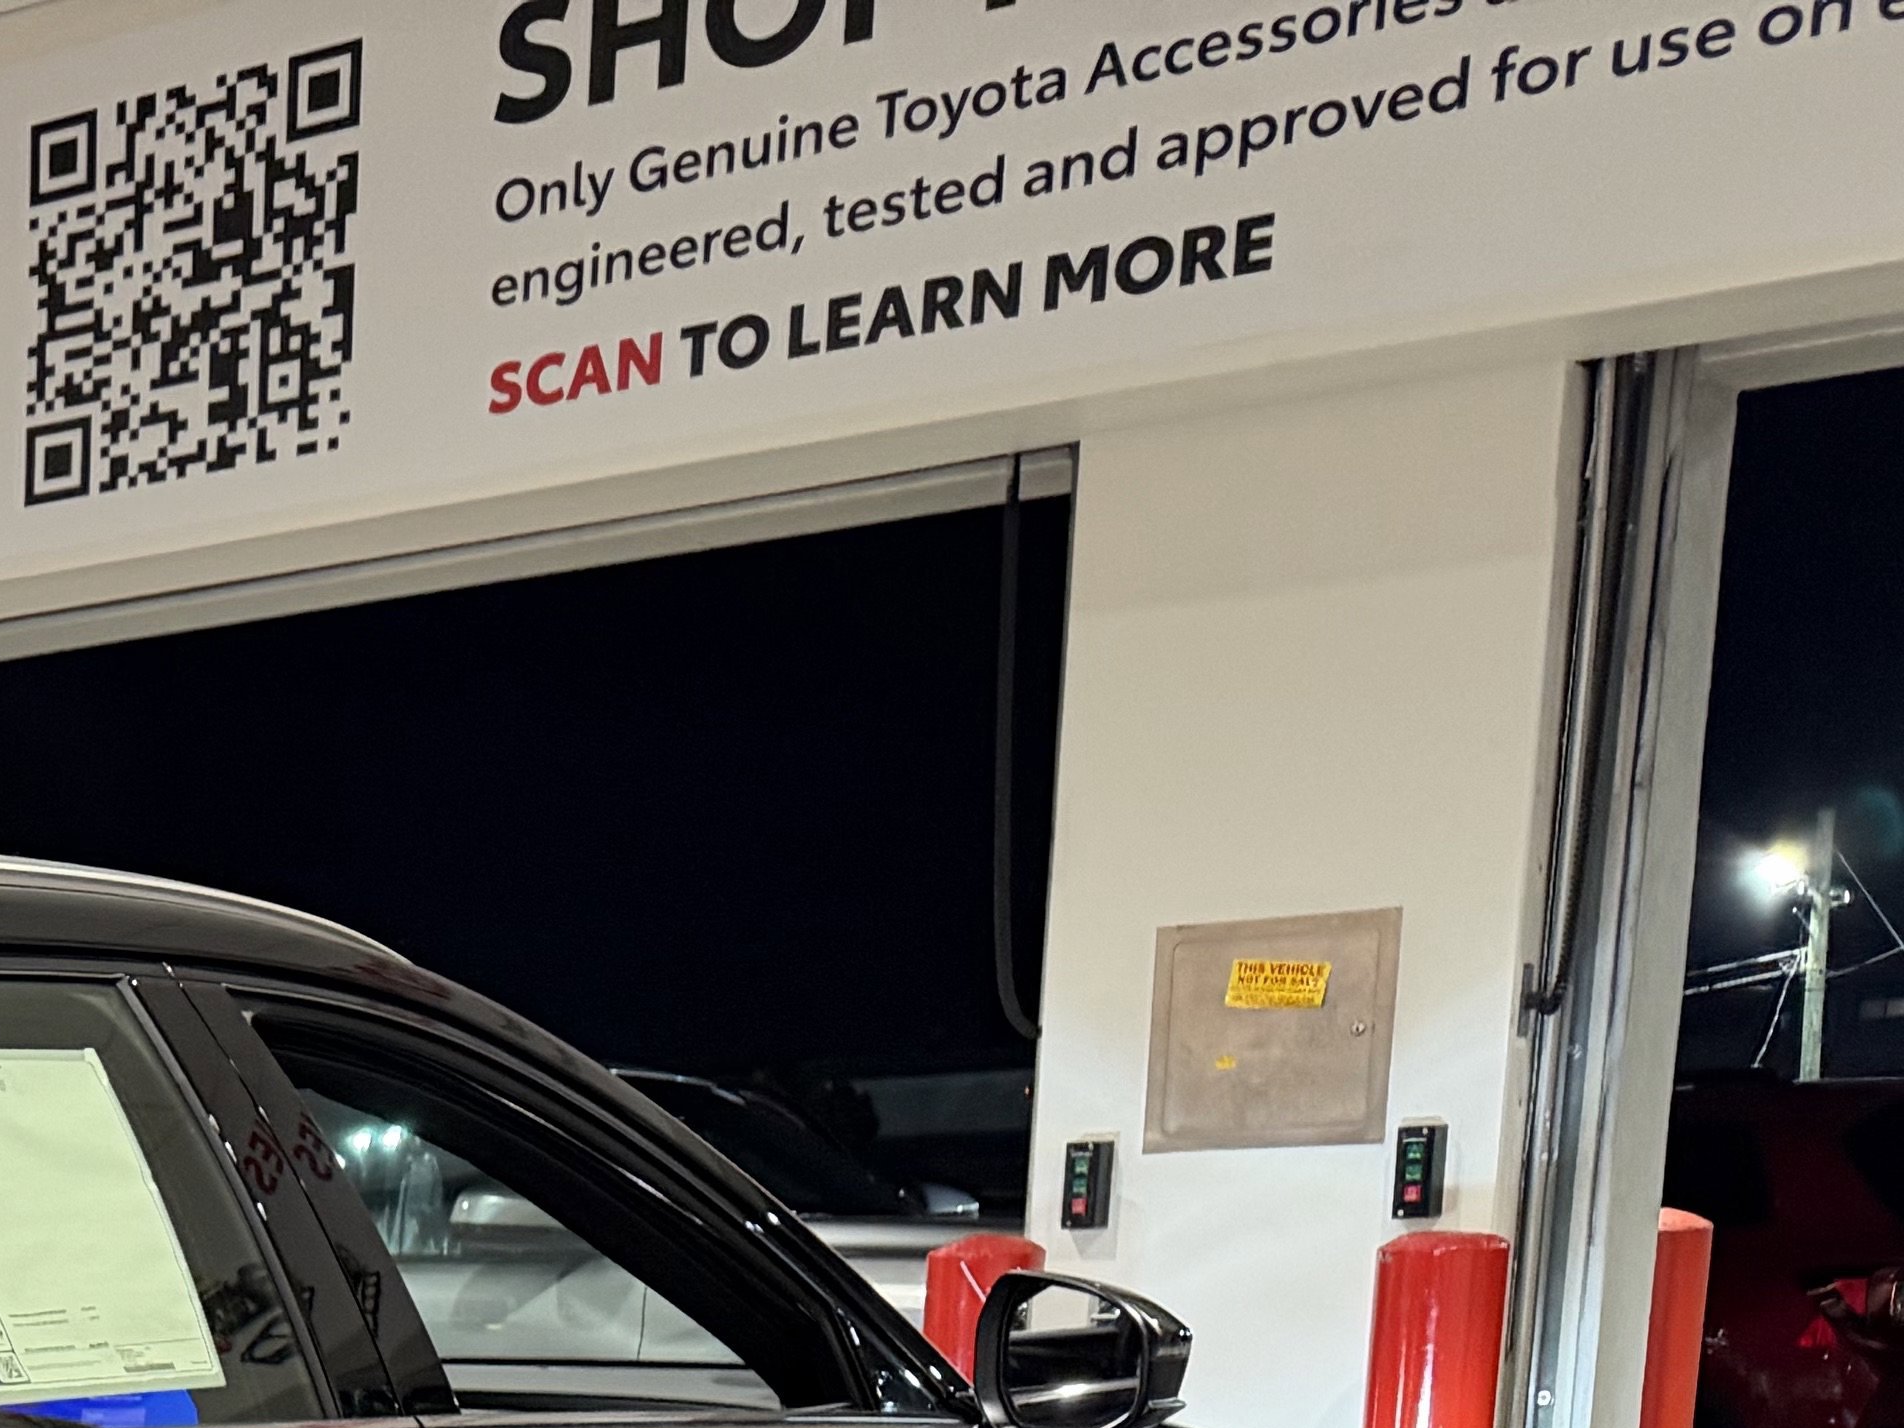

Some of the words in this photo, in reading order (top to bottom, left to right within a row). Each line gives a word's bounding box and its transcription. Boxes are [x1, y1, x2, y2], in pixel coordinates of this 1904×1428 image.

[491, 201, 806, 306] engineered,
[823, 154, 1005, 238] tested
[1023, 126, 1138, 197] and
[1156, 55, 1471, 177] approved
[1491, 45, 1592, 102] for
[1611, 18, 1736, 77] use
[1758, 0, 1852, 45] on
[495, 161, 615, 222] Only
[629, 114, 860, 193] Genuine
[876, 66, 1067, 139] Toyota
[489, 331, 663, 414] SCAN
[680, 313, 771, 378] TO
[788, 262, 1023, 360] LEARN
[1044, 213, 1276, 312] MORE
